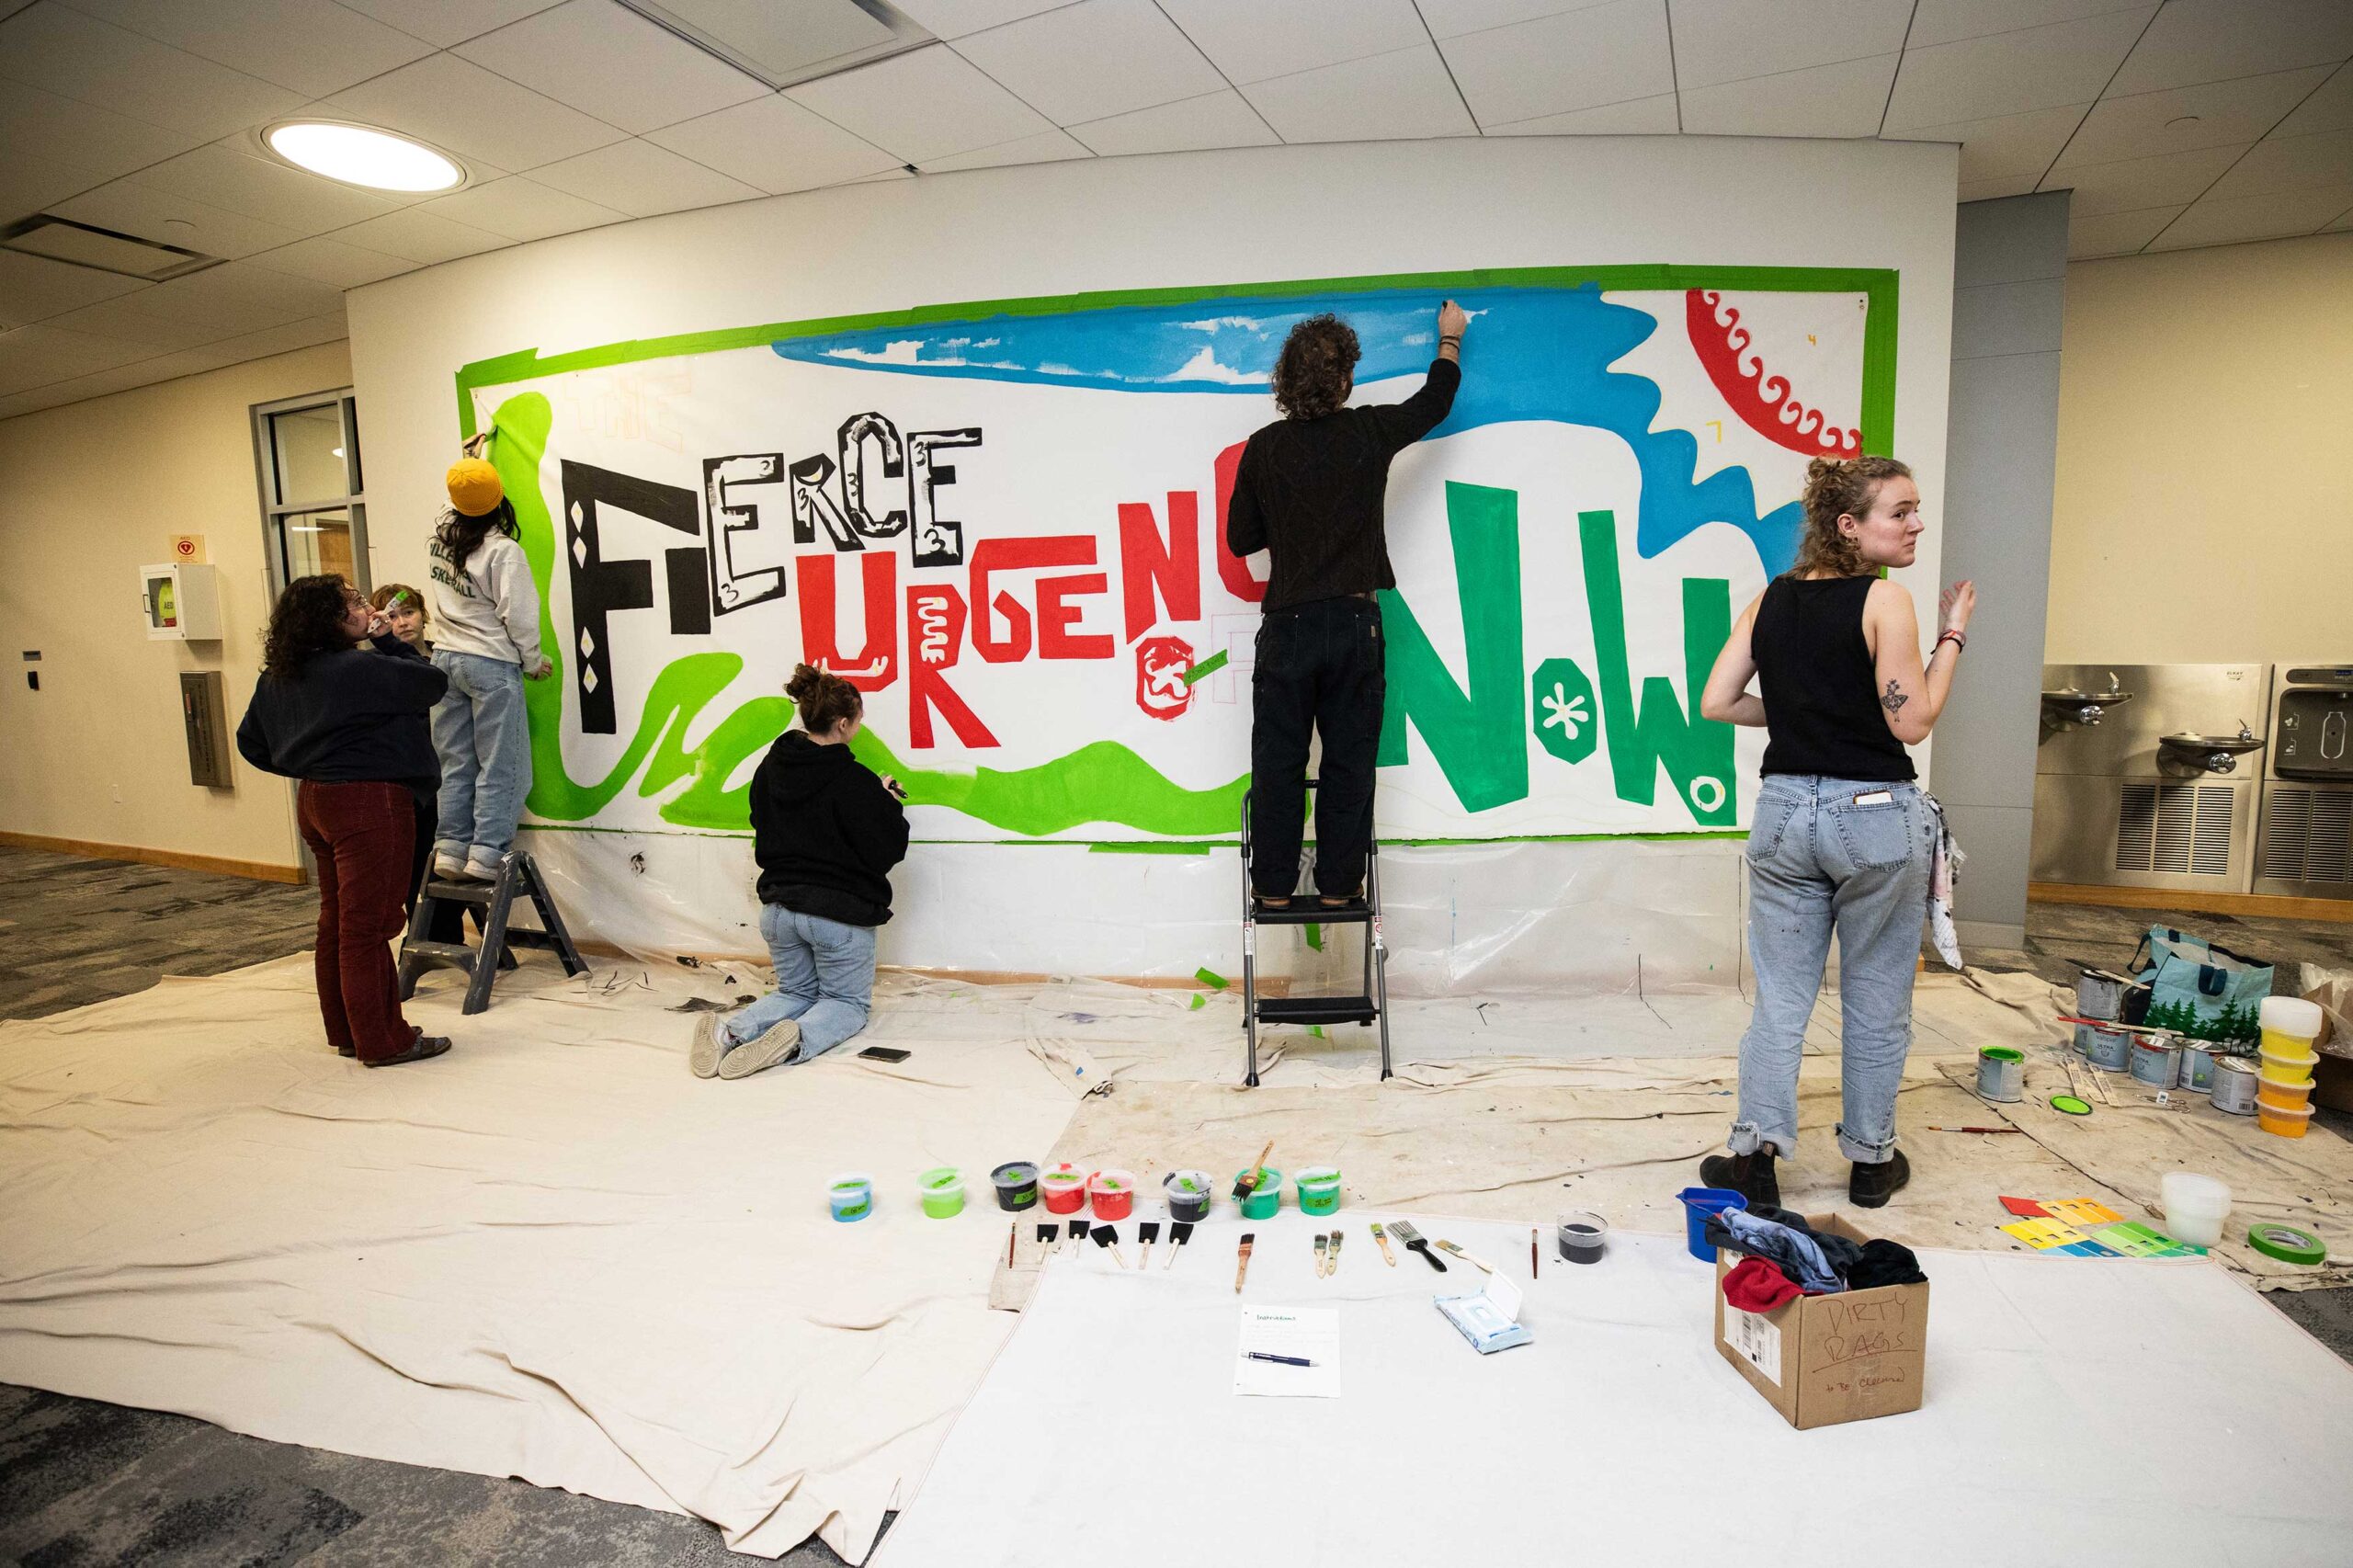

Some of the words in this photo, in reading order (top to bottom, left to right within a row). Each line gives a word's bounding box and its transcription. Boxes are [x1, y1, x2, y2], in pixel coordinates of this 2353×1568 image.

[560, 411, 983, 734] FIERCE
[1815, 1290, 1908, 1336] DIRTY
[1824, 1331, 1904, 1362] RAGS
